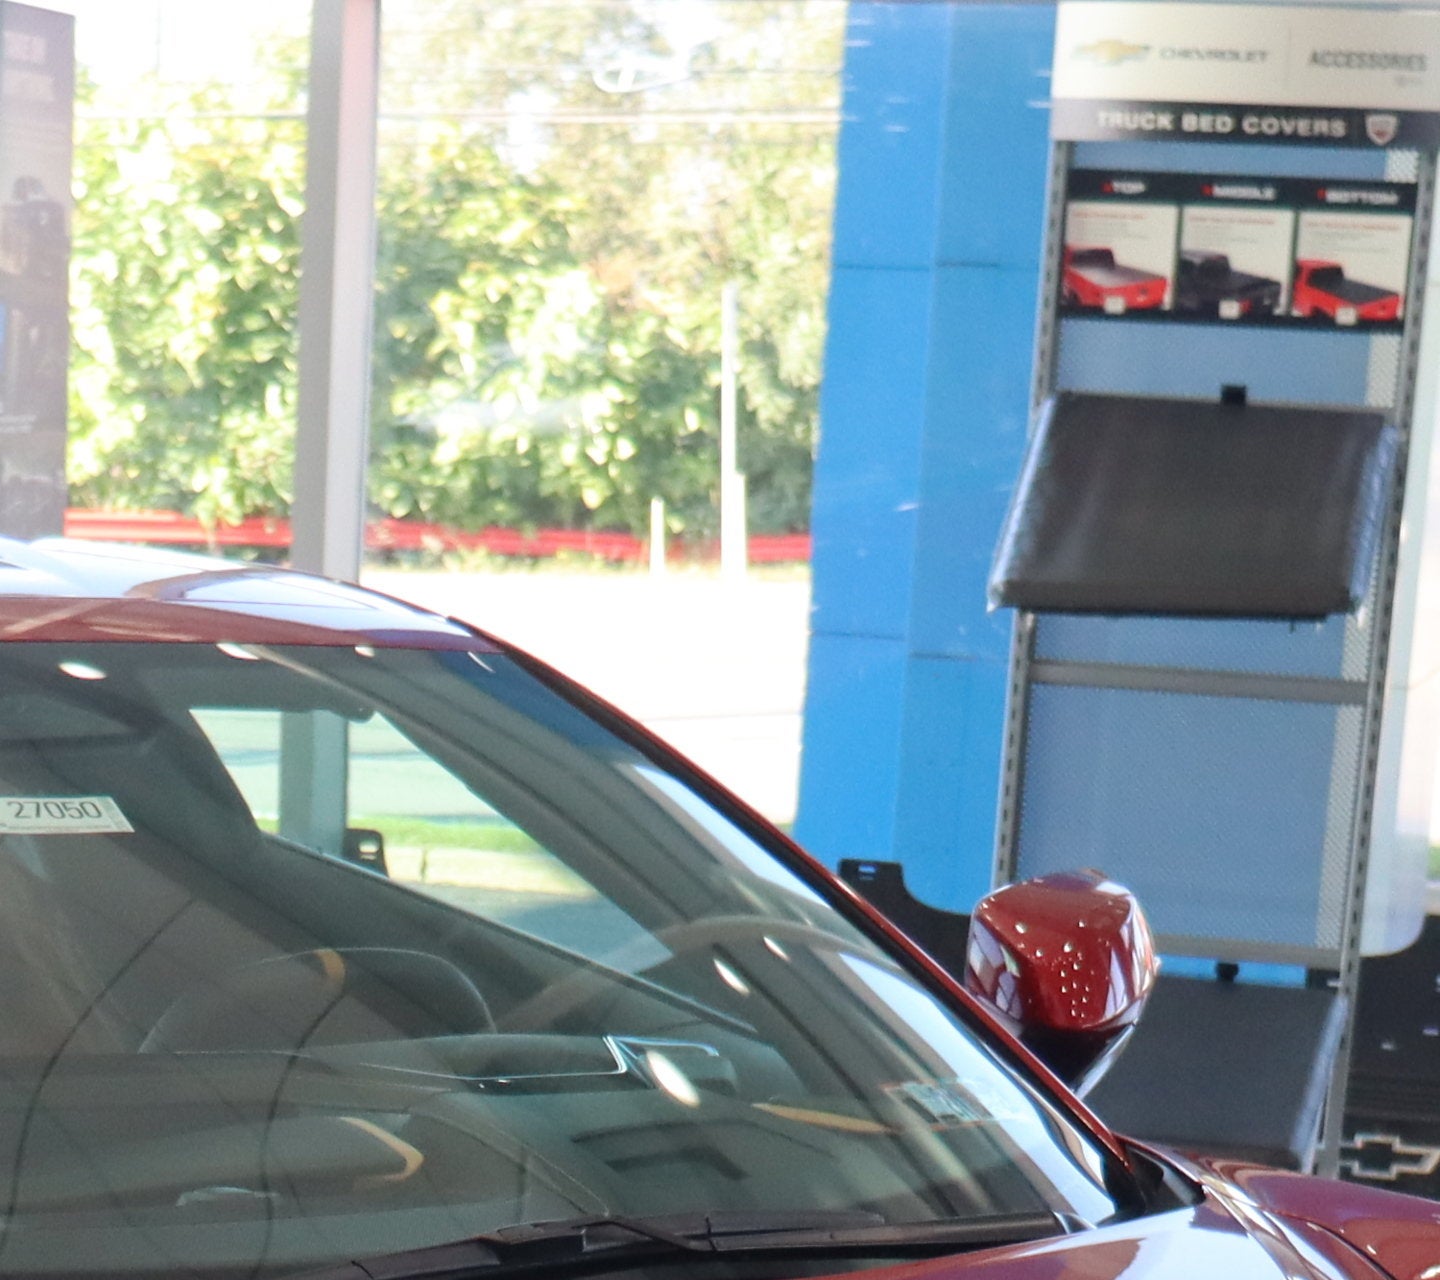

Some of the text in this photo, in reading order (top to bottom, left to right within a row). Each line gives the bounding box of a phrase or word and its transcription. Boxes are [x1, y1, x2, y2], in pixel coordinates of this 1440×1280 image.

[1160, 48, 1269, 64] CHEVROLET
[1309, 50, 1428, 72] ACCESSORIES
[1097, 111, 1347, 137] TRUCK BED COVERS
[7, 801, 103, 820] 27050
